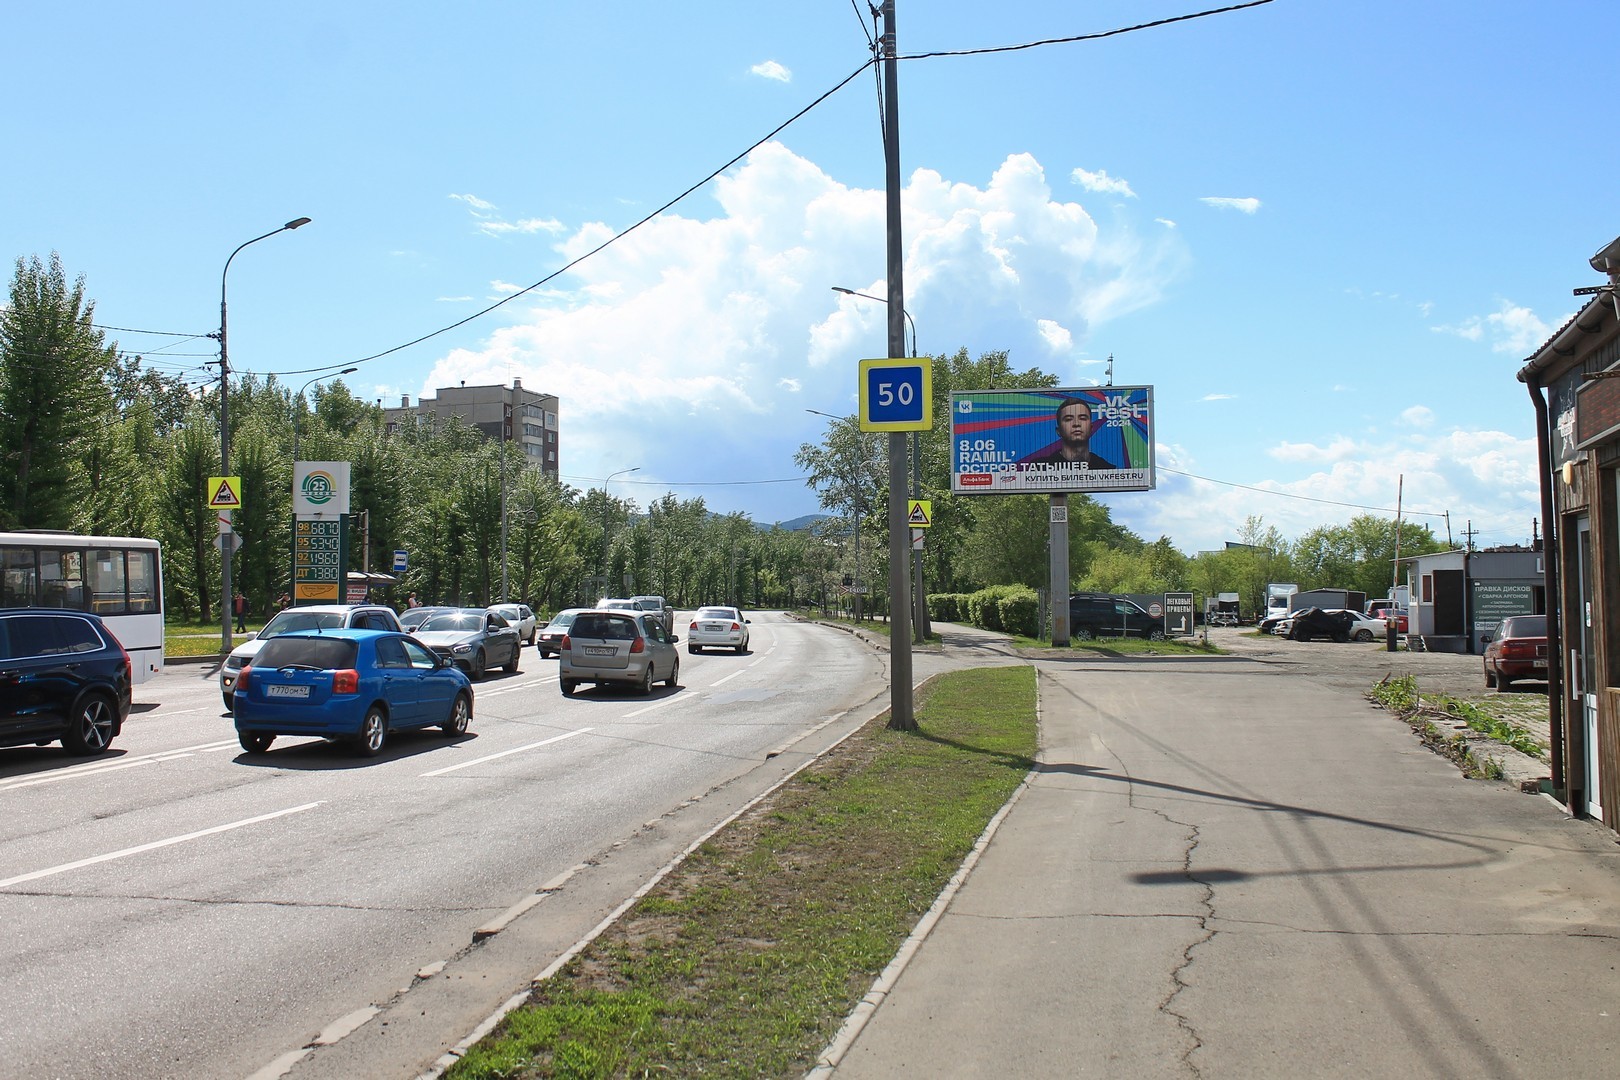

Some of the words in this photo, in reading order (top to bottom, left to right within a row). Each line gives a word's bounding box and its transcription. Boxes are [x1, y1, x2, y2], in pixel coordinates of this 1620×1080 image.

[879, 382, 913, 406] 50
[1105, 395, 1131, 407] VK
[1095, 403, 1143, 420] fest
[959, 439, 995, 451] 8.06
[959, 463, 1018, 474] ОСТРОВ
[1020, 461, 1089, 472] ТАТЫШЕВ
[1098, 473, 1144, 481] VKFEST.RU
[312, 481, 325, 491] 25
[298, 523, 309, 531] 98
[298, 537, 309, 546] 95
[297, 552, 308, 561] 92
[296, 568, 309, 578] ДТ
